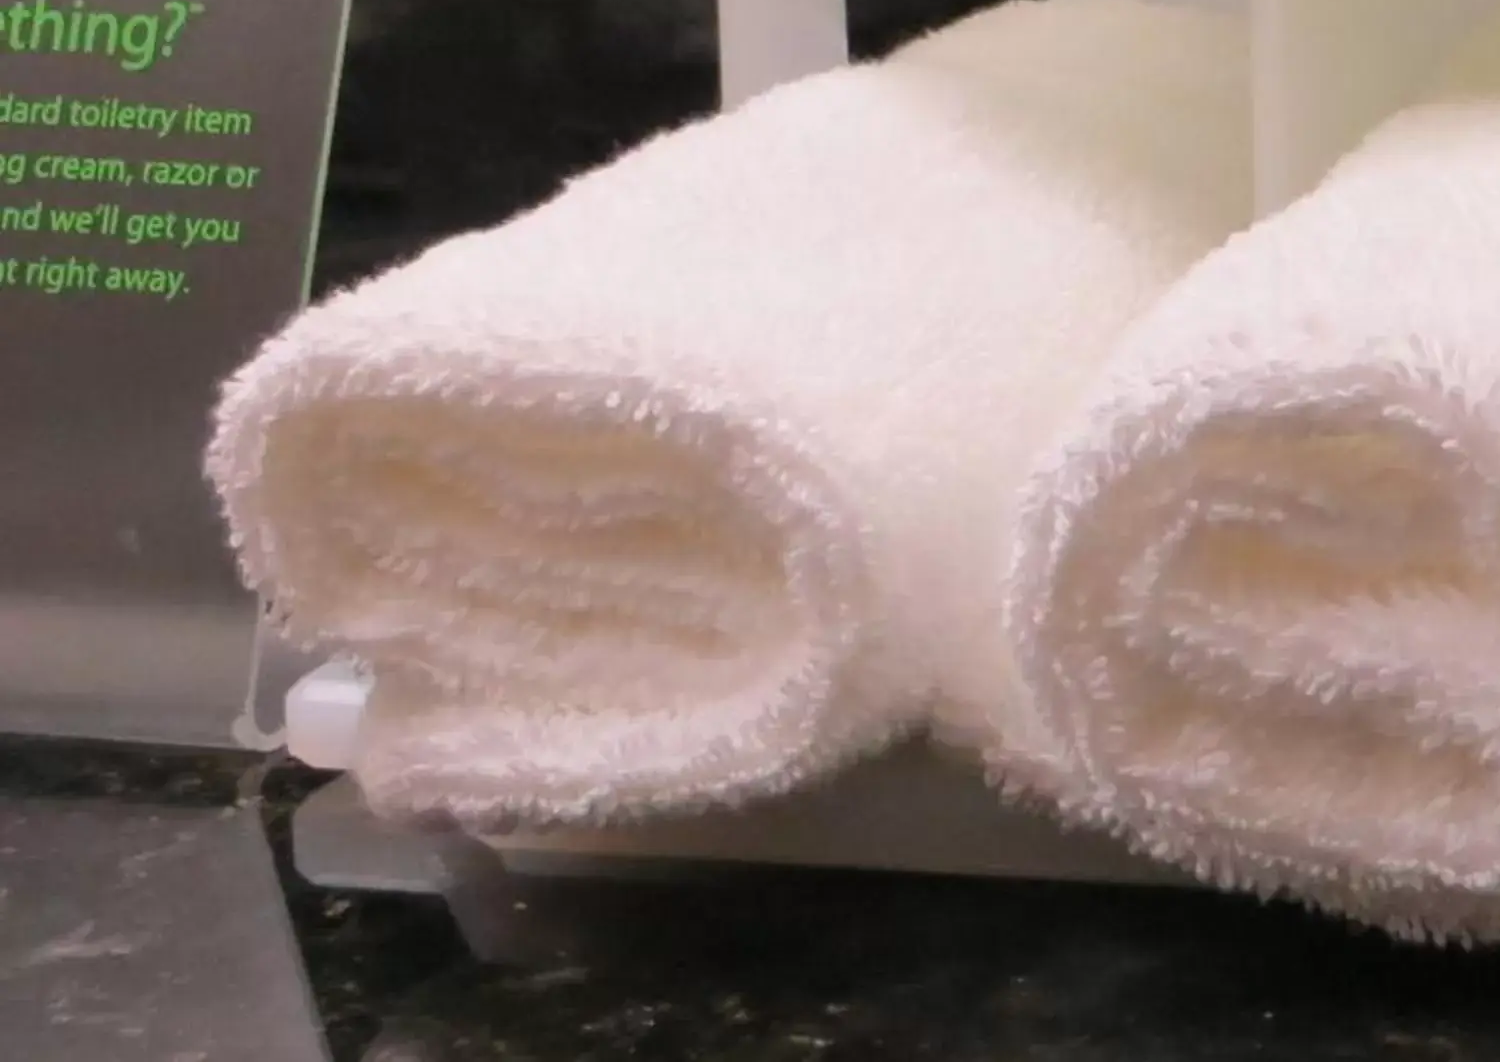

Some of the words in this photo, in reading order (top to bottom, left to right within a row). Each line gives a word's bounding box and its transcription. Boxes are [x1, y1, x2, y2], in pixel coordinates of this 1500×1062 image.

[70, 96, 179, 138] toiletry
[184, 102, 252, 136] item
[34, 154, 134, 187] cream,
[142, 160, 221, 187] razor
[225, 164, 261, 190] or
[50, 202, 120, 236] we'll
[126, 210, 178, 245] get
[181, 216, 241, 250] you
[25, 254, 99, 295] right
[105, 265, 190, 302] away.
